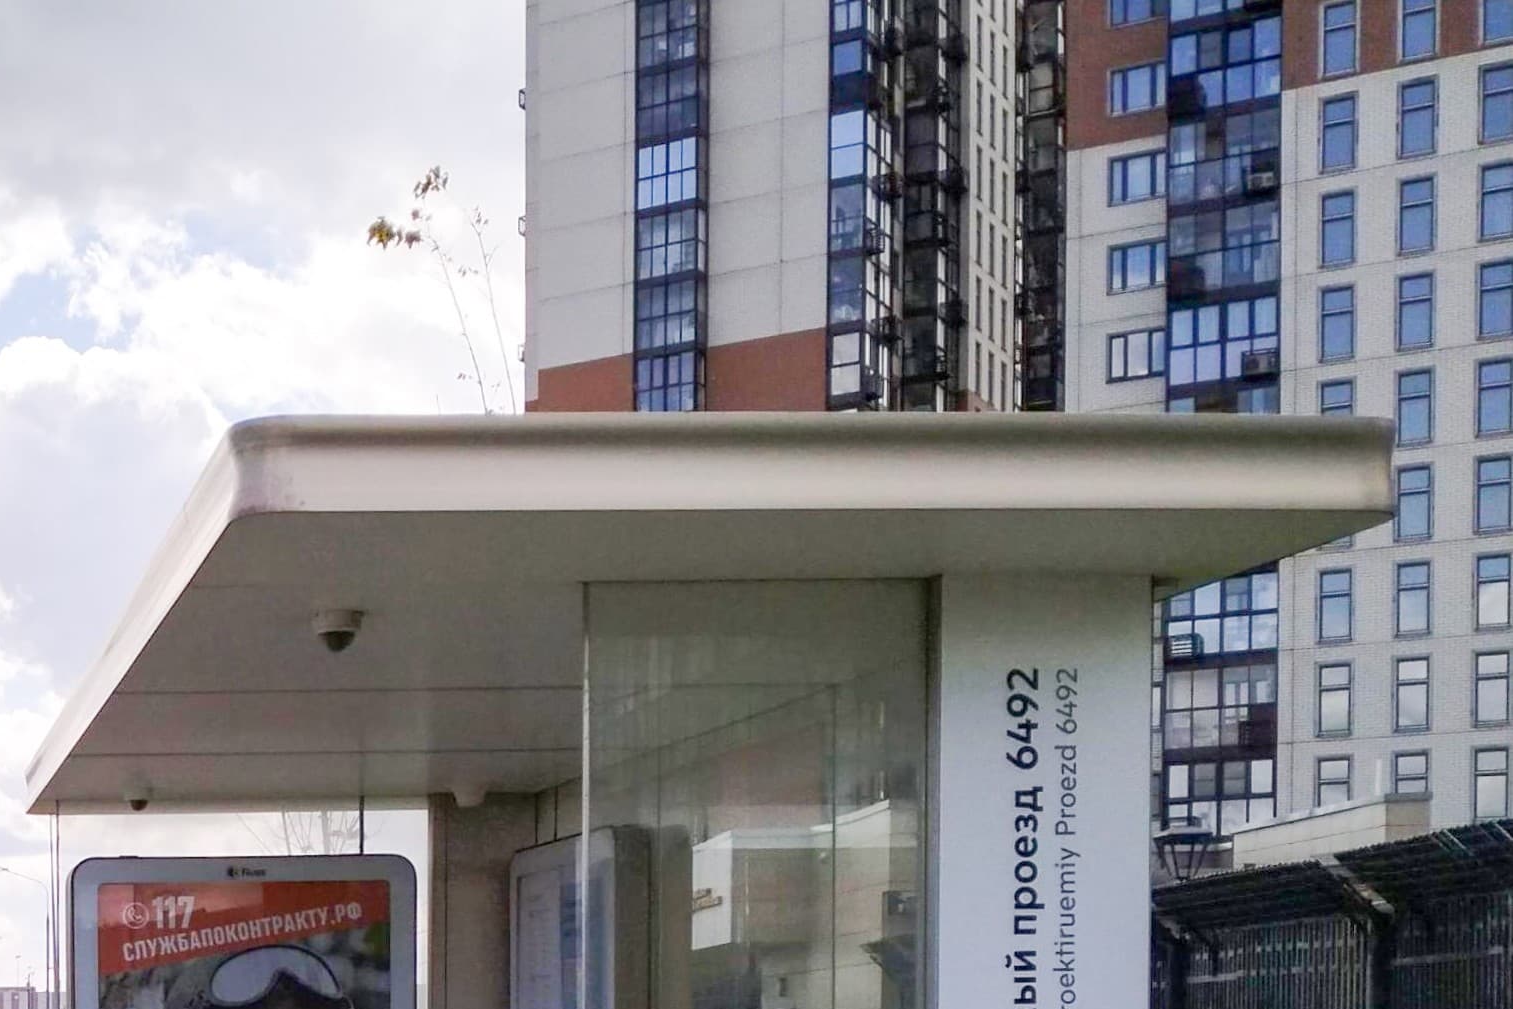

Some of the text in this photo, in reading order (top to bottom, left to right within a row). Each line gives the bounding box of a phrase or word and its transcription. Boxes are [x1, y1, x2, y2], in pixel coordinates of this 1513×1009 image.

[1005, 666, 1040, 770] 6492
[1056, 667, 1078, 735] 6492
[1055, 743, 1078, 836] Proezd
[1013, 786, 1044, 934] проезд
[122, 901, 363, 962] СЛУЖБАПОКОНТРАКТУ.РФ
[152, 895, 195, 929] 117
